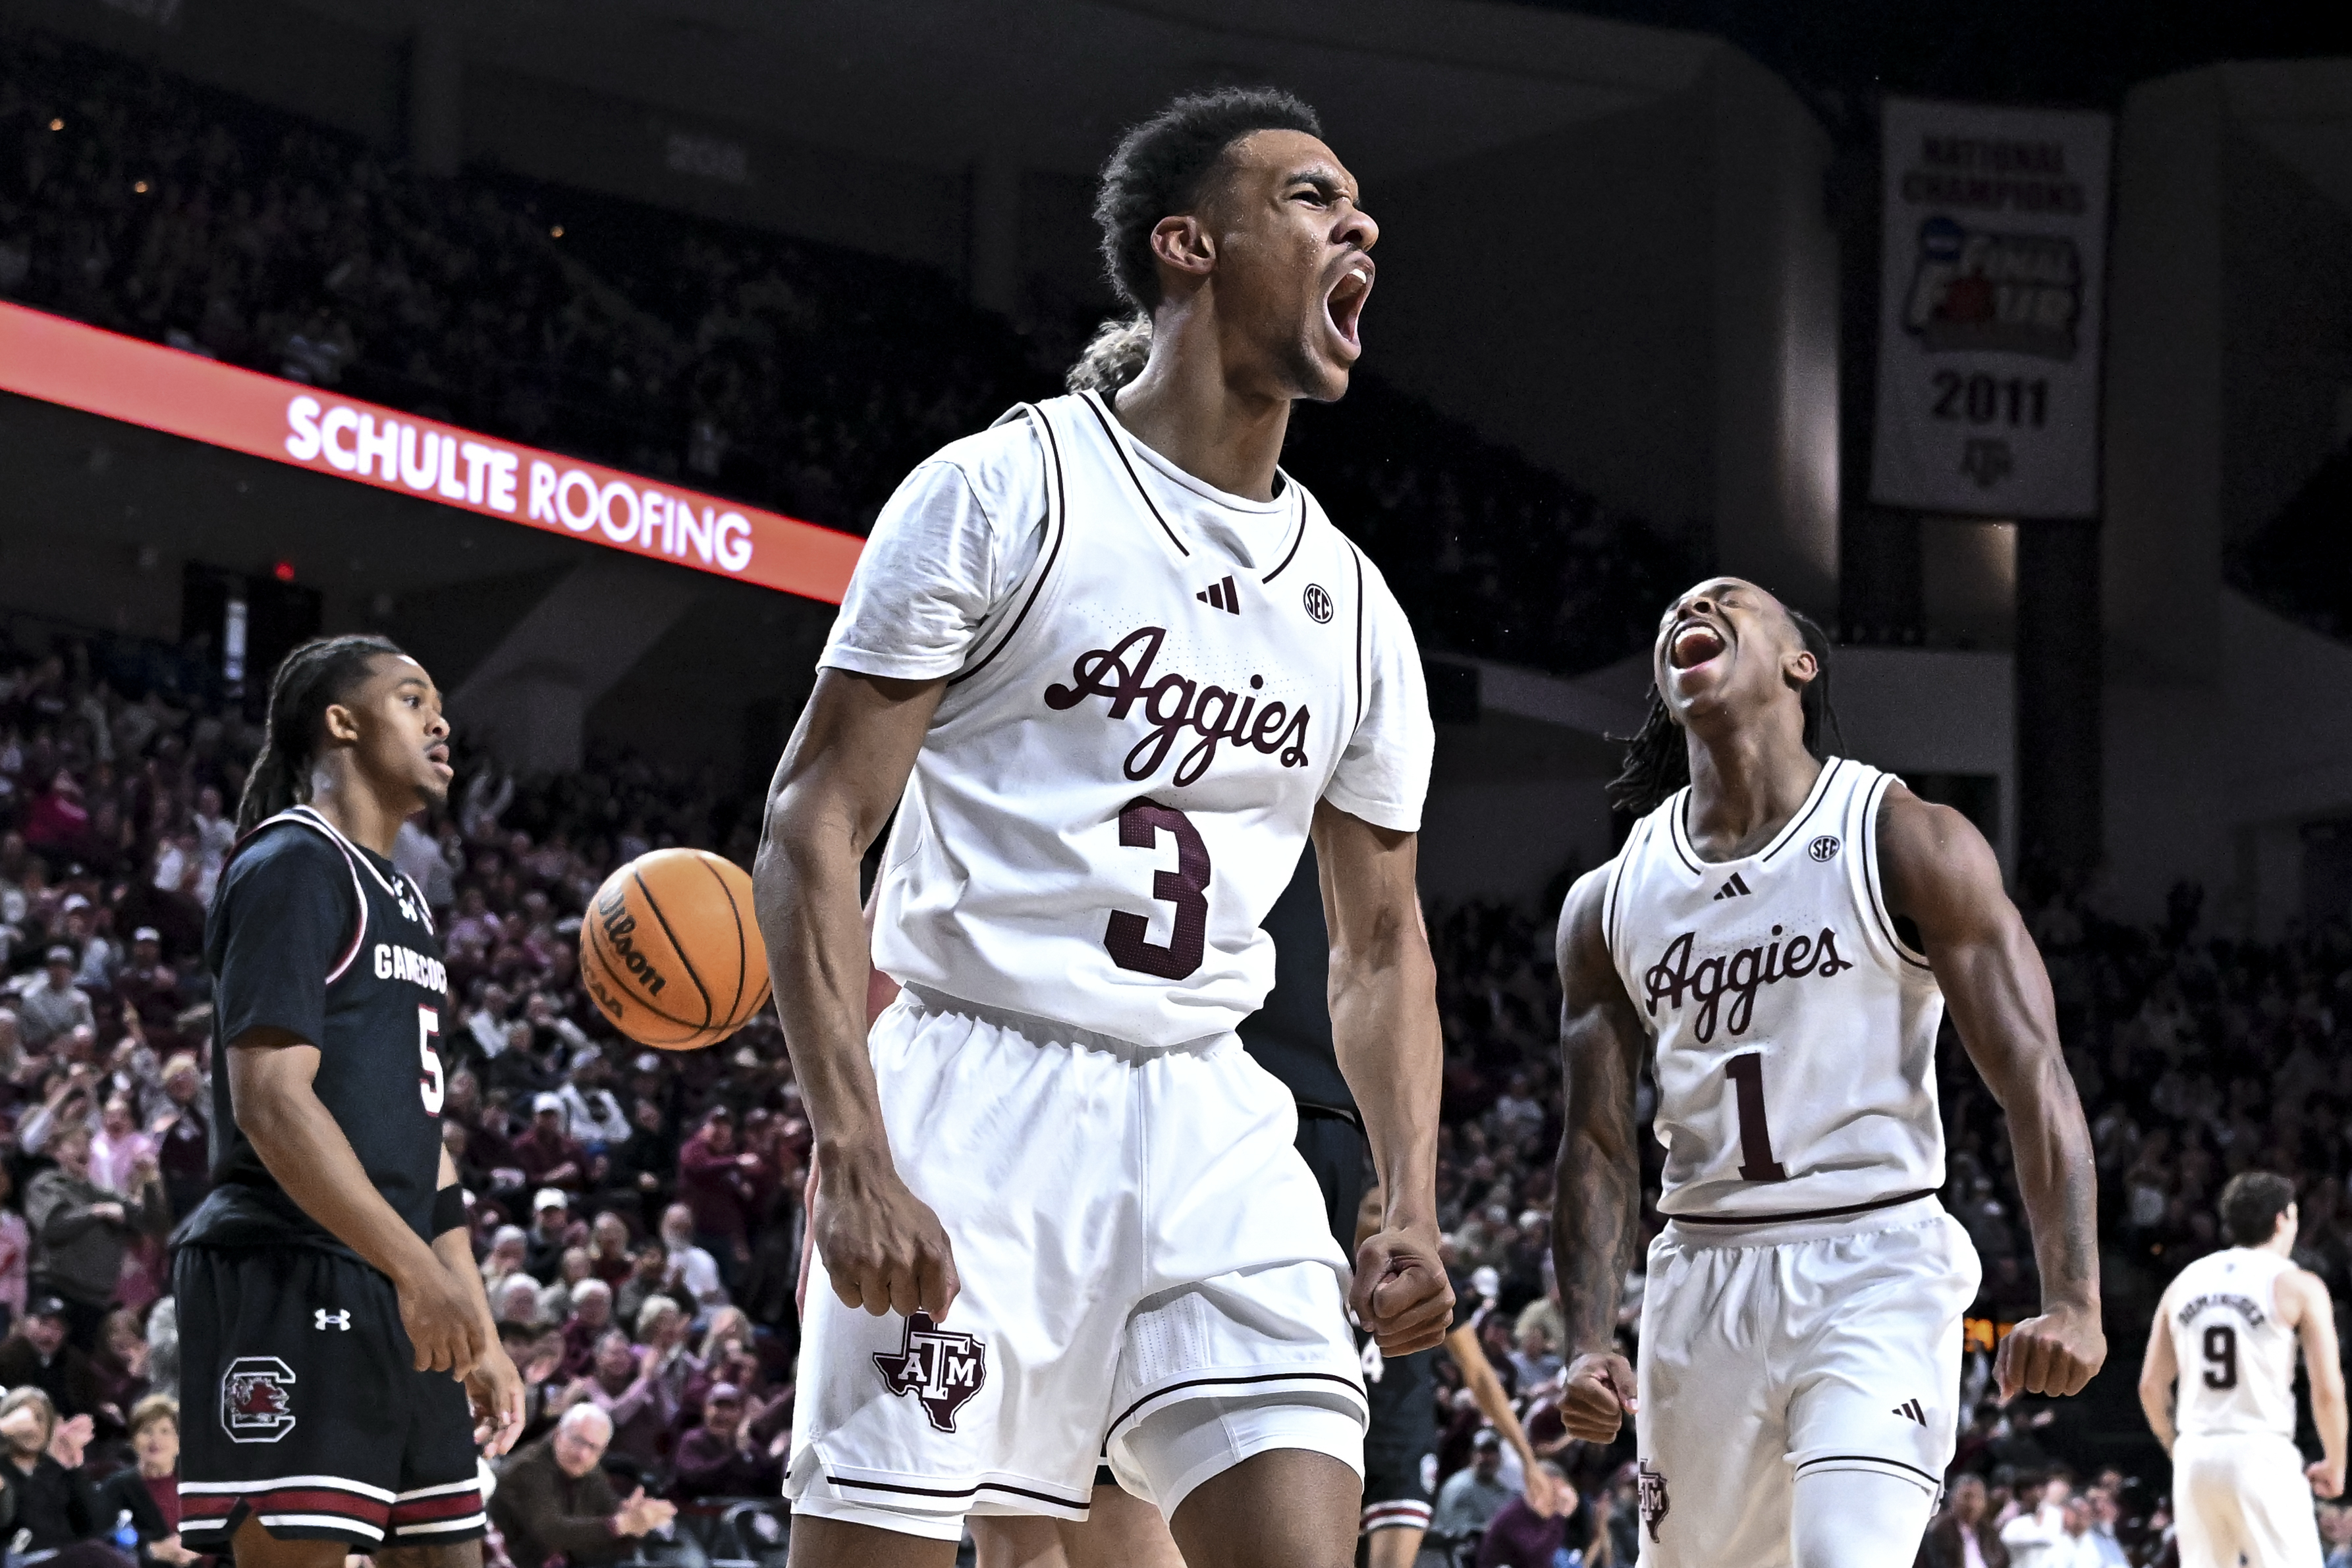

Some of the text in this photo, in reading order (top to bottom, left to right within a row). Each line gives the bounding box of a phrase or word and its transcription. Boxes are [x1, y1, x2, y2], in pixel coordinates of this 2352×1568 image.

[1932, 369, 2048, 429] 2011
[285, 396, 753, 572] SCHULTE ROOFING
[1306, 586, 1331, 621] SEC
[1044, 626, 1311, 788] Aggies
[1103, 795, 1211, 981] 3
[1811, 837, 1838, 860] SEC
[597, 886, 666, 997] Wilson
[1645, 924, 1854, 1044] Aggies
[418, 1002, 445, 1118] 5
[1725, 1052, 1786, 1181] 1
[2203, 1324, 2237, 1391] 9
